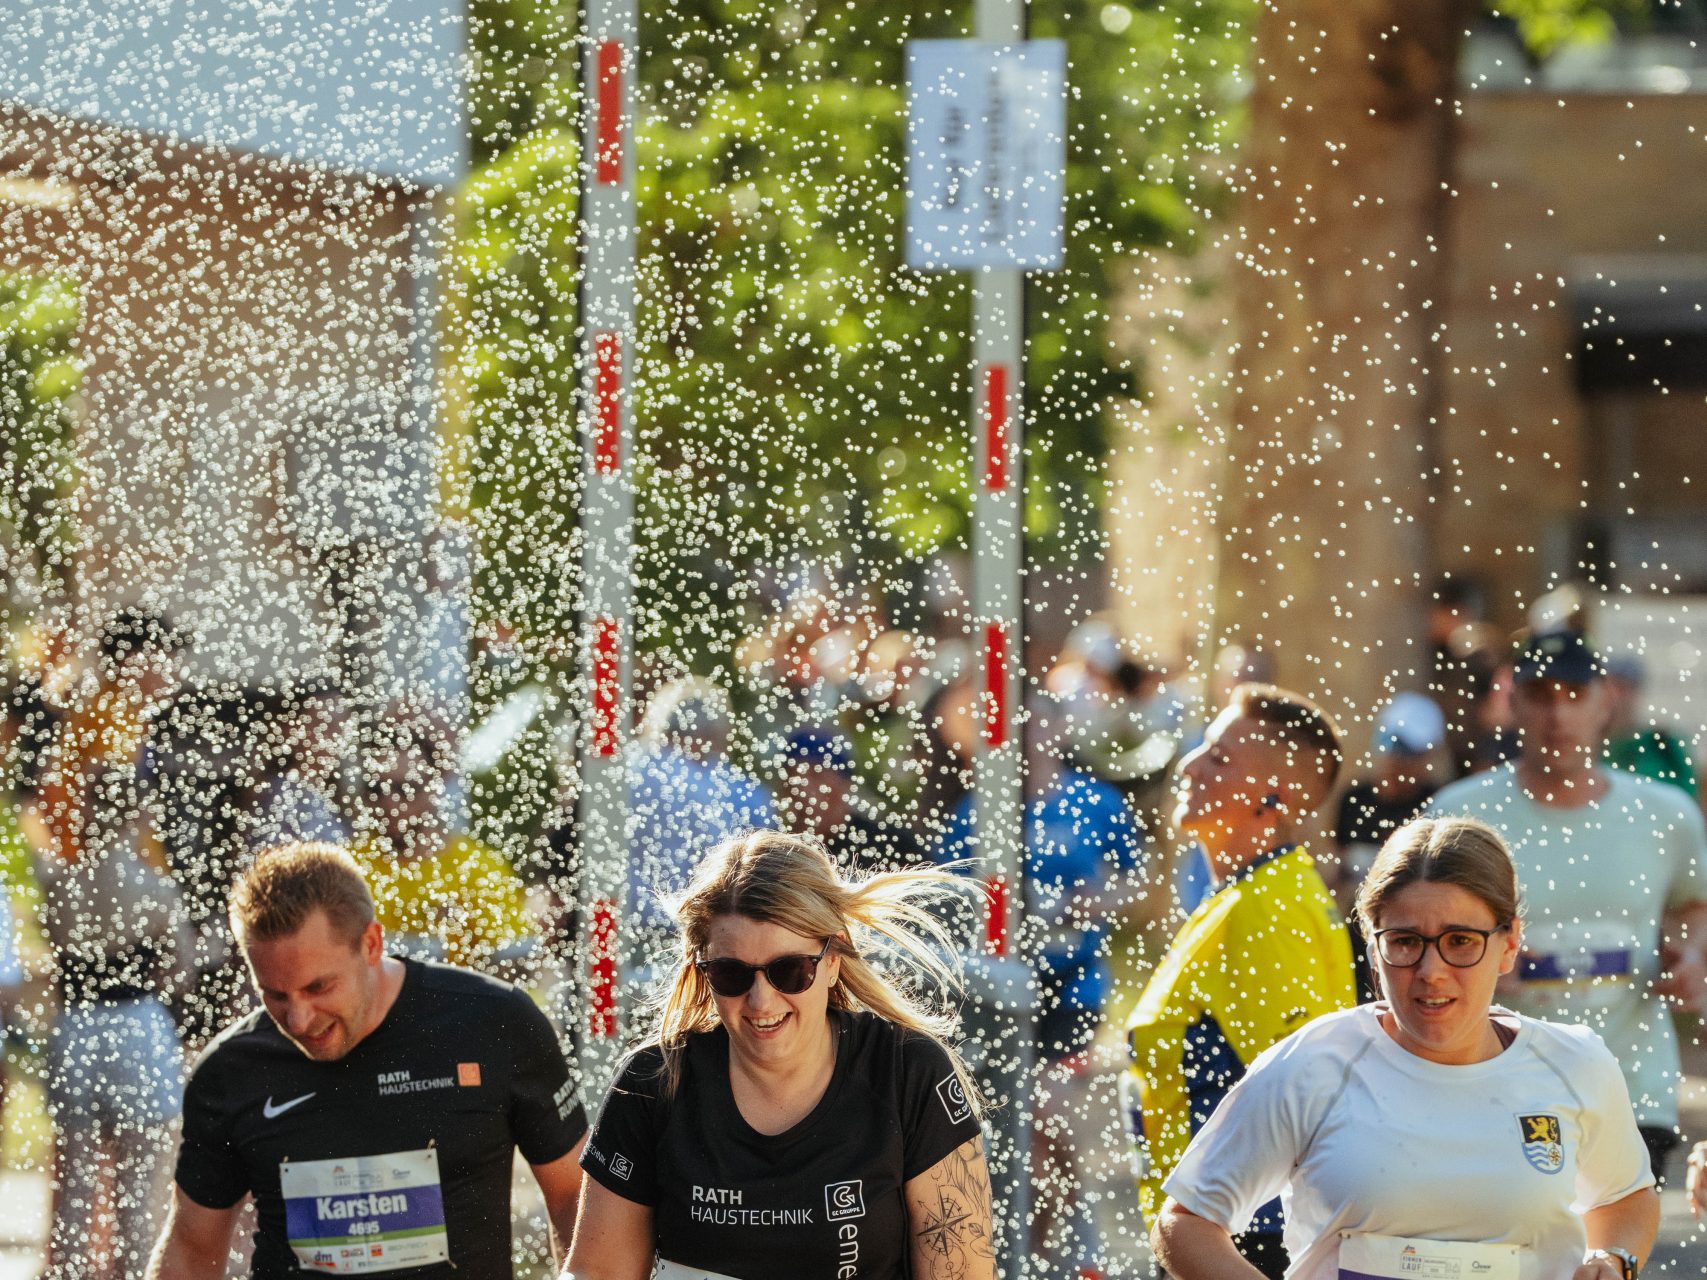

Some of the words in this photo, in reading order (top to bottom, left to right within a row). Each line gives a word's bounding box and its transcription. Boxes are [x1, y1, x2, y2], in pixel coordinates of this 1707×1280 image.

[378, 1070, 411, 1085] RATH
[379, 1077, 455, 1096] HAUSTECHNIK
[692, 1185, 743, 1206] RATH
[316, 1194, 408, 1221] Karsten
[691, 1206, 814, 1226] HAUSTECHNIK
[348, 1221, 380, 1236] 4695
[1402, 1263, 1422, 1271] LAUF
